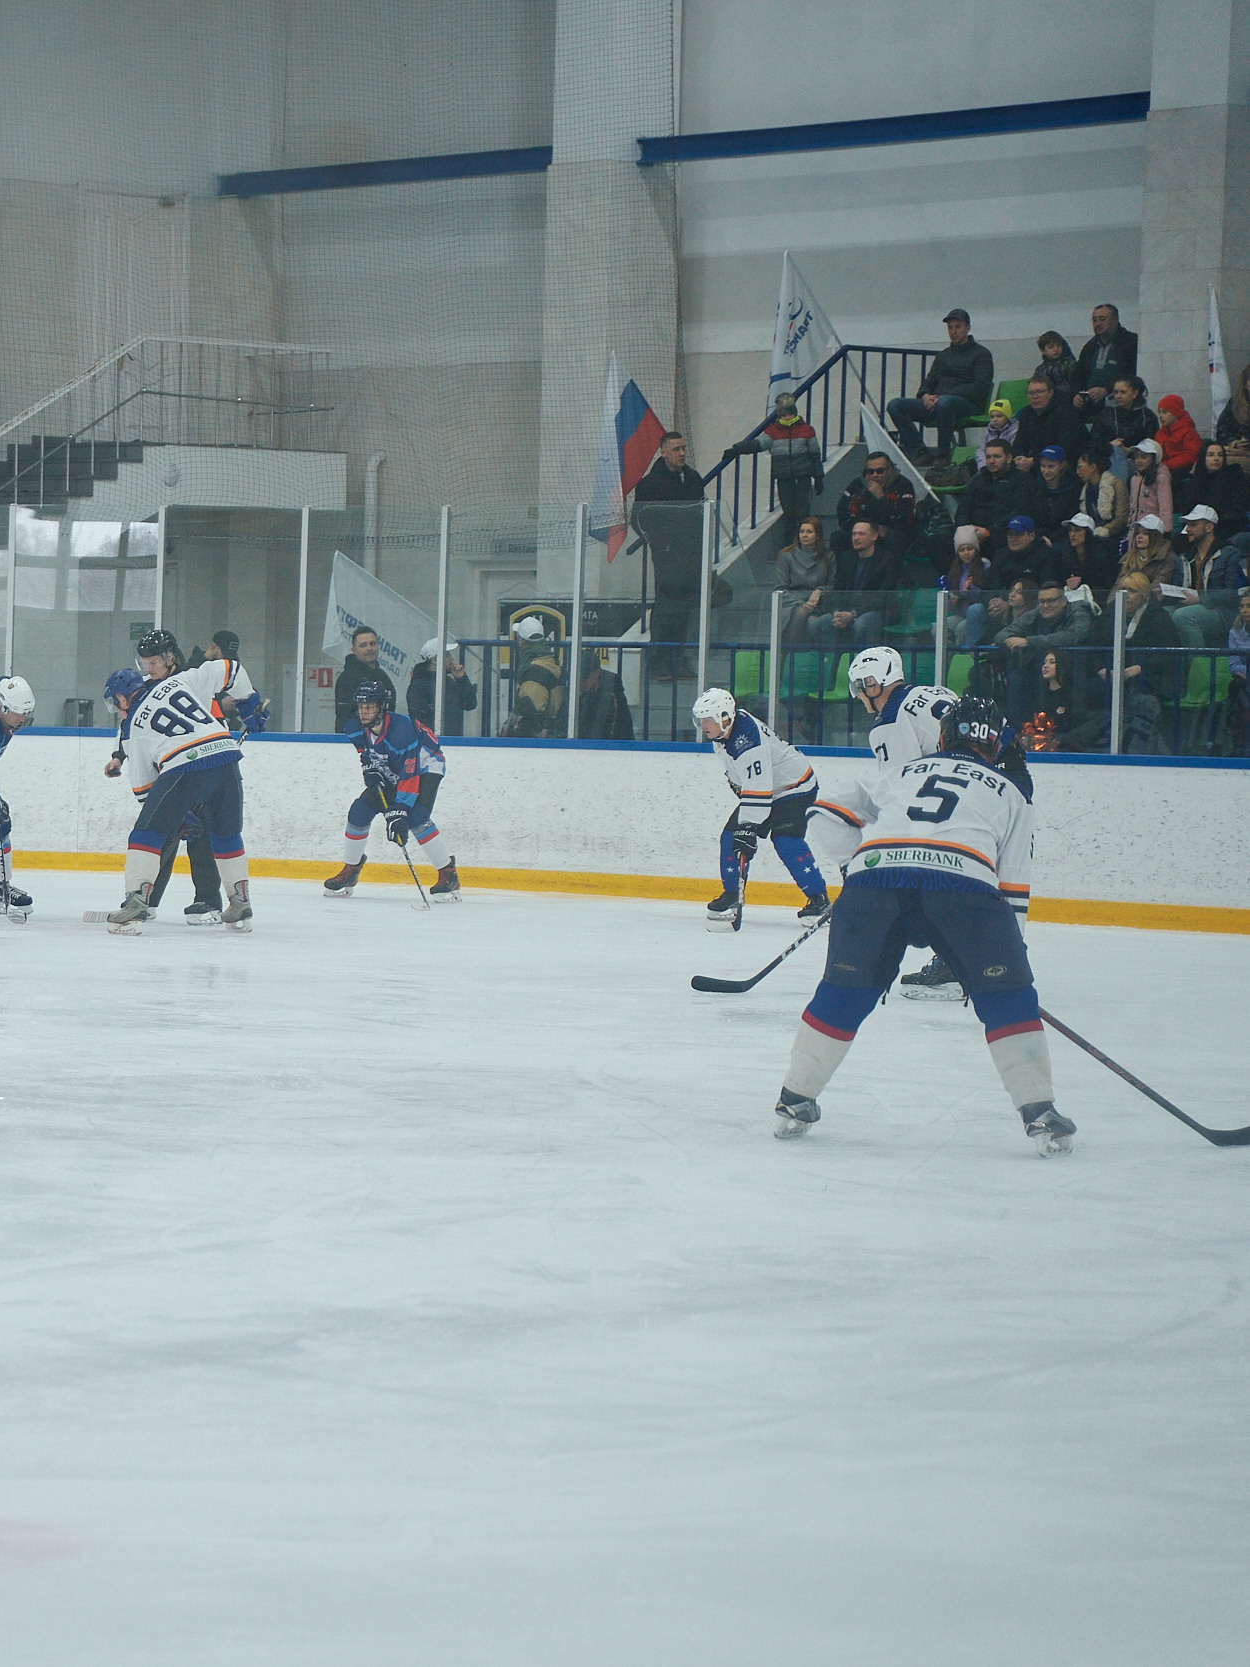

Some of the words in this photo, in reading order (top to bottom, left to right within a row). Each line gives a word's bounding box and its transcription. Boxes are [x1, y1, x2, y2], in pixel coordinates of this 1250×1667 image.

[134, 705, 153, 730] Far
[152, 679, 184, 701] East
[903, 694, 930, 717] Far
[970, 721, 989, 740] 30
[746, 760, 762, 779] 78
[901, 762, 940, 778] Far
[952, 763, 1007, 797] East
[906, 774, 971, 824] 5
[885, 850, 964, 869] SBERBANK
